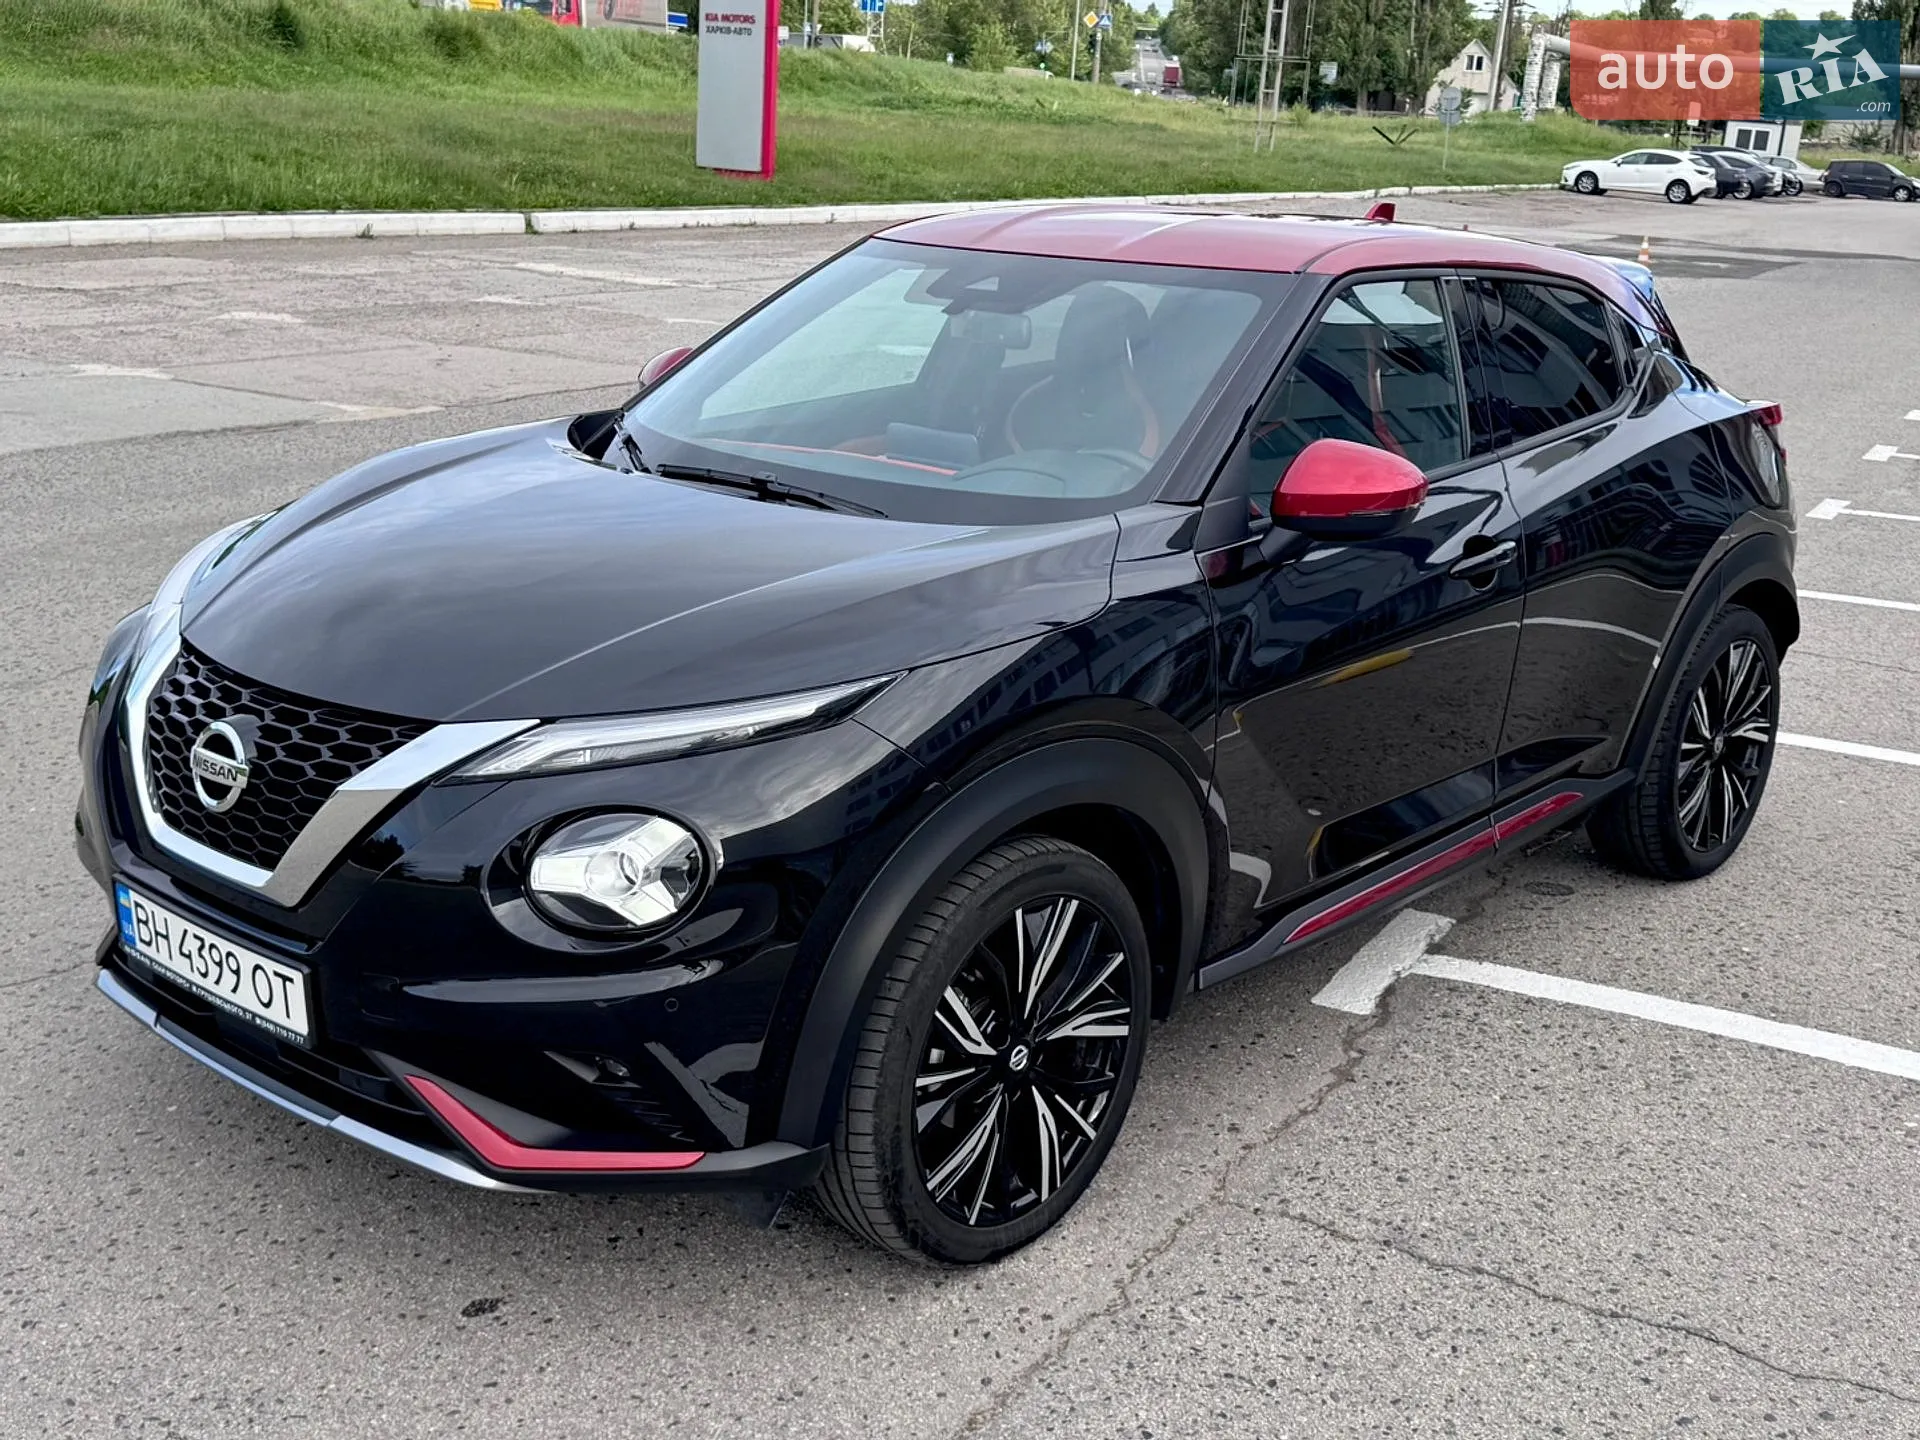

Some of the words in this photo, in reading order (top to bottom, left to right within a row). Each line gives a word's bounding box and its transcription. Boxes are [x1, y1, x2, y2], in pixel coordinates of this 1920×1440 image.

[705, 13, 719, 22] KIA
[721, 13, 756, 24] MOTORS
[193, 755, 238, 782] NISSAN
[133, 900, 173, 961] BH
[178, 929, 241, 994] 4399
[251, 963, 295, 1020] OT
